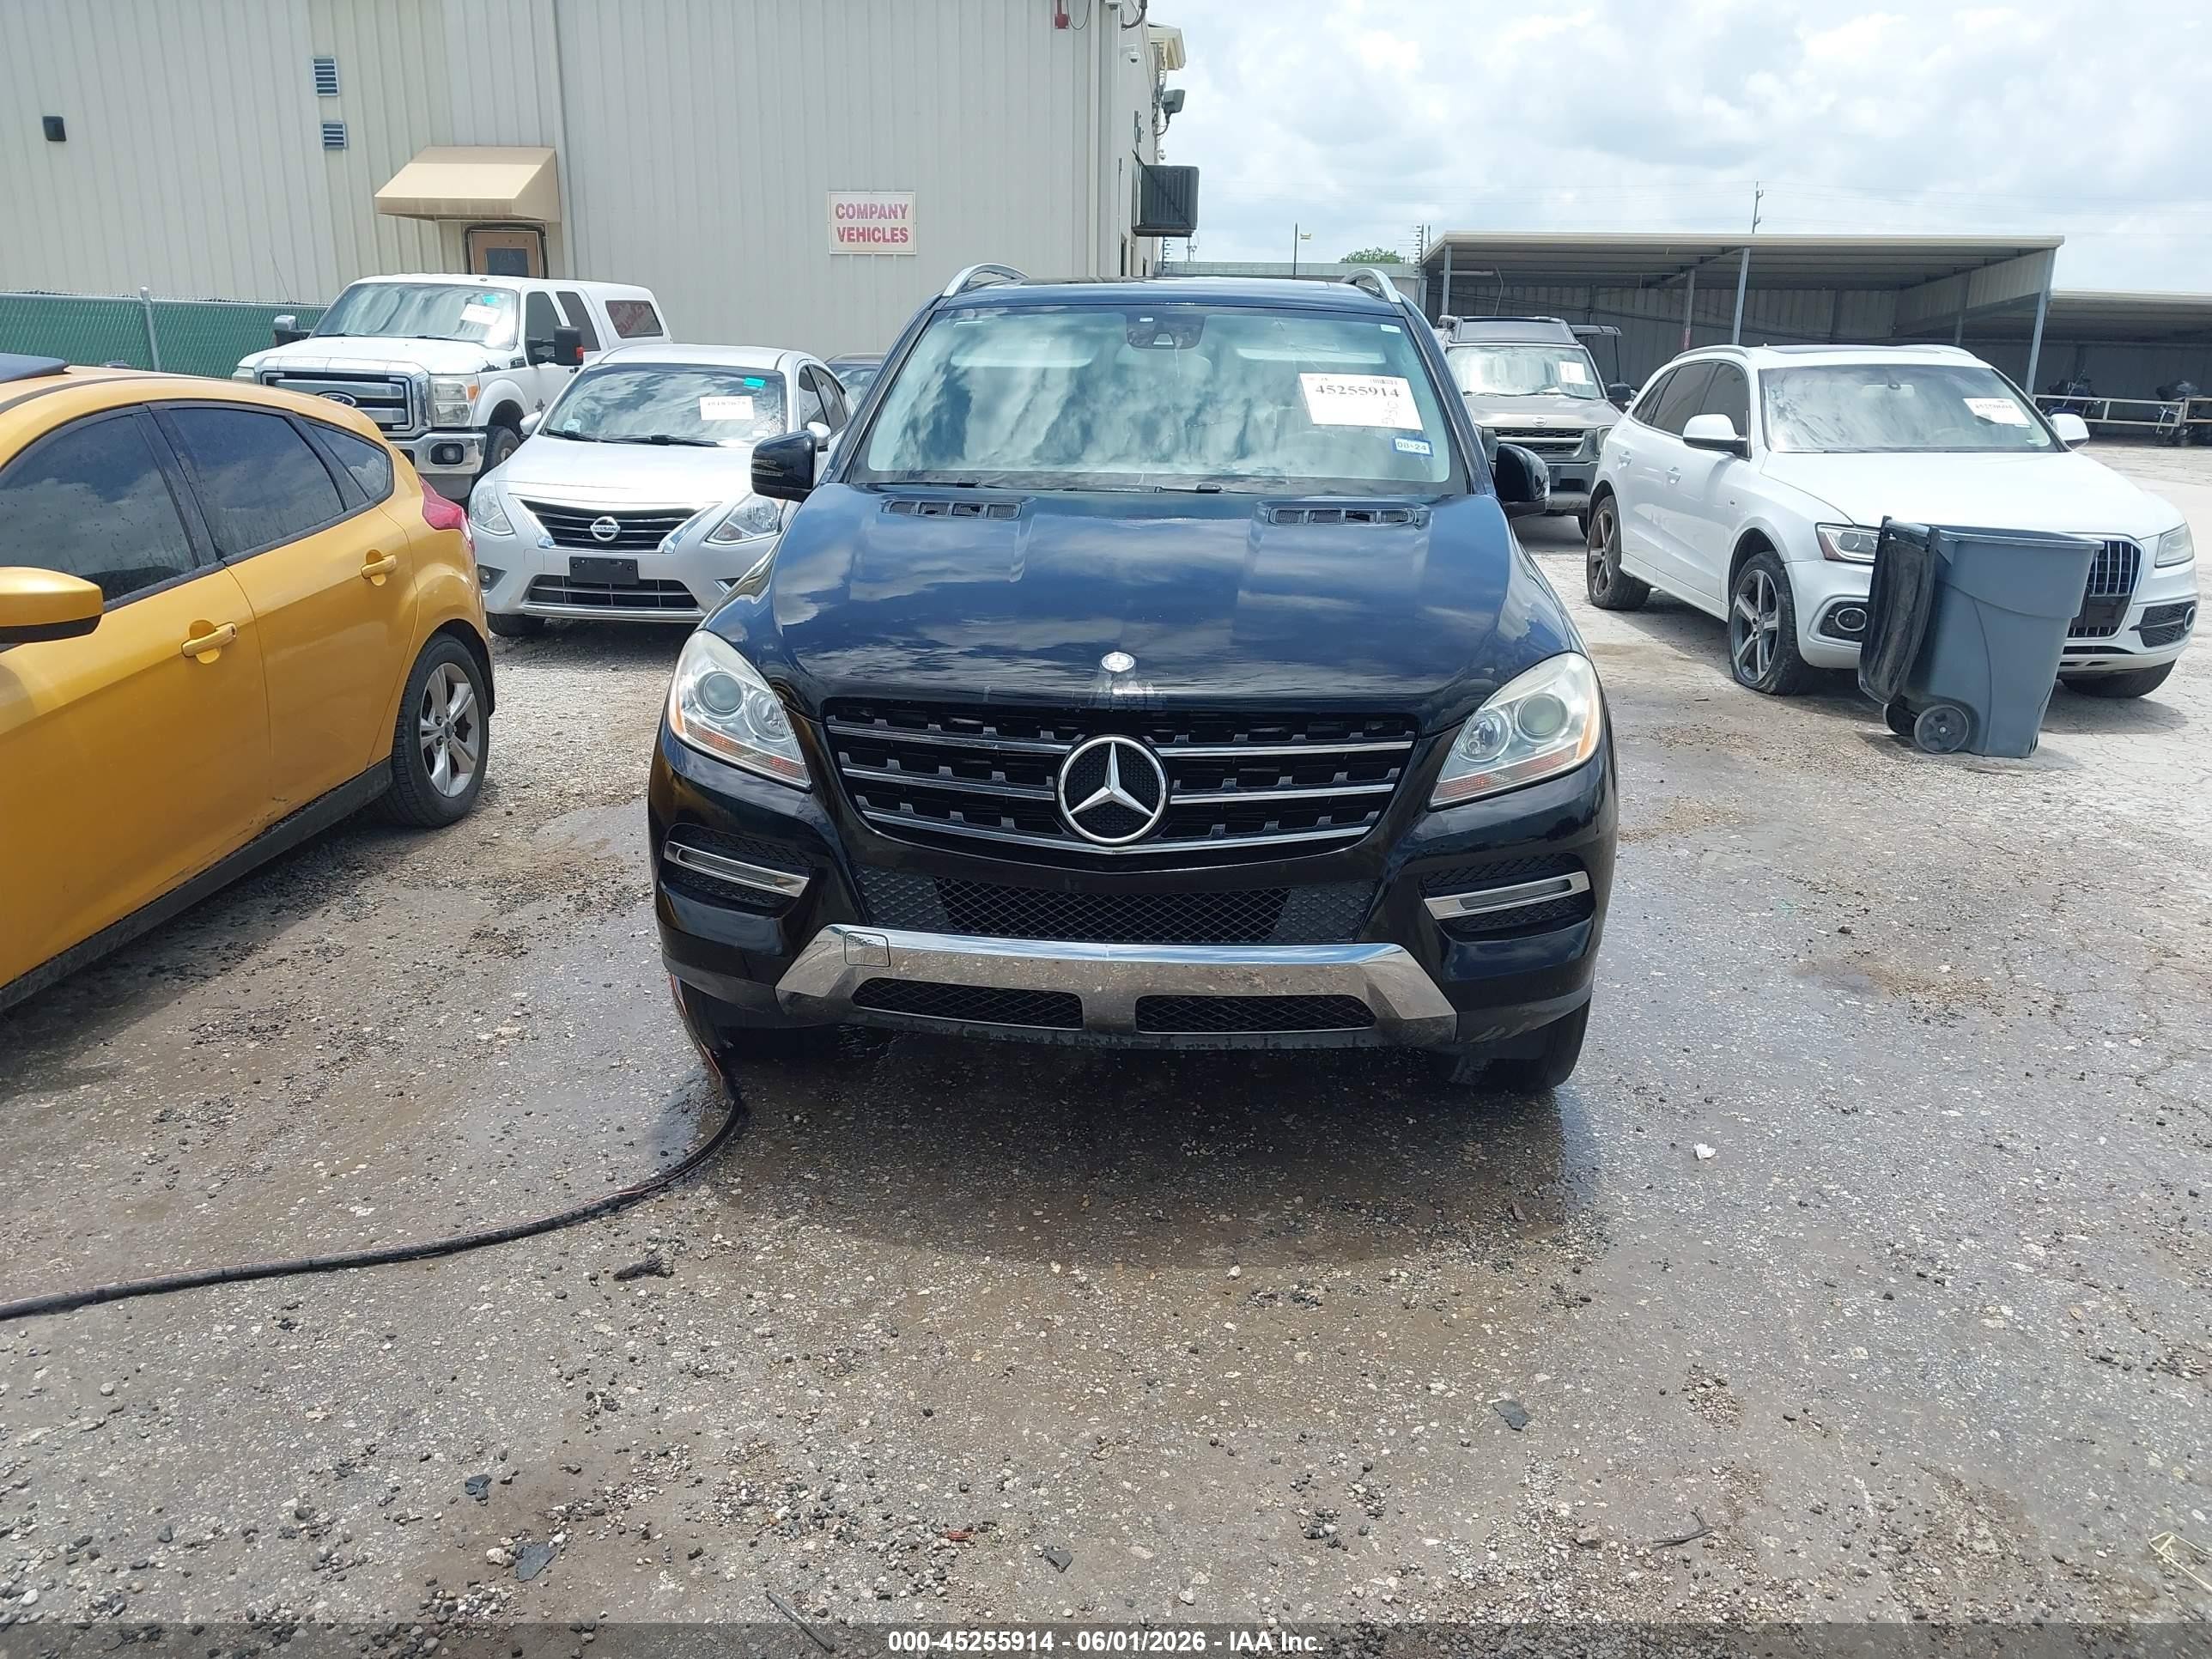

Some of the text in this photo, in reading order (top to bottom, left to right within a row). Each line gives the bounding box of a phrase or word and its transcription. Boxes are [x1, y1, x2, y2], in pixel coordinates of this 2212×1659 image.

[835, 203, 908, 220] COMPANY
[836, 226, 908, 243] VEHICLES
[1316, 384, 1400, 398] 45255914
